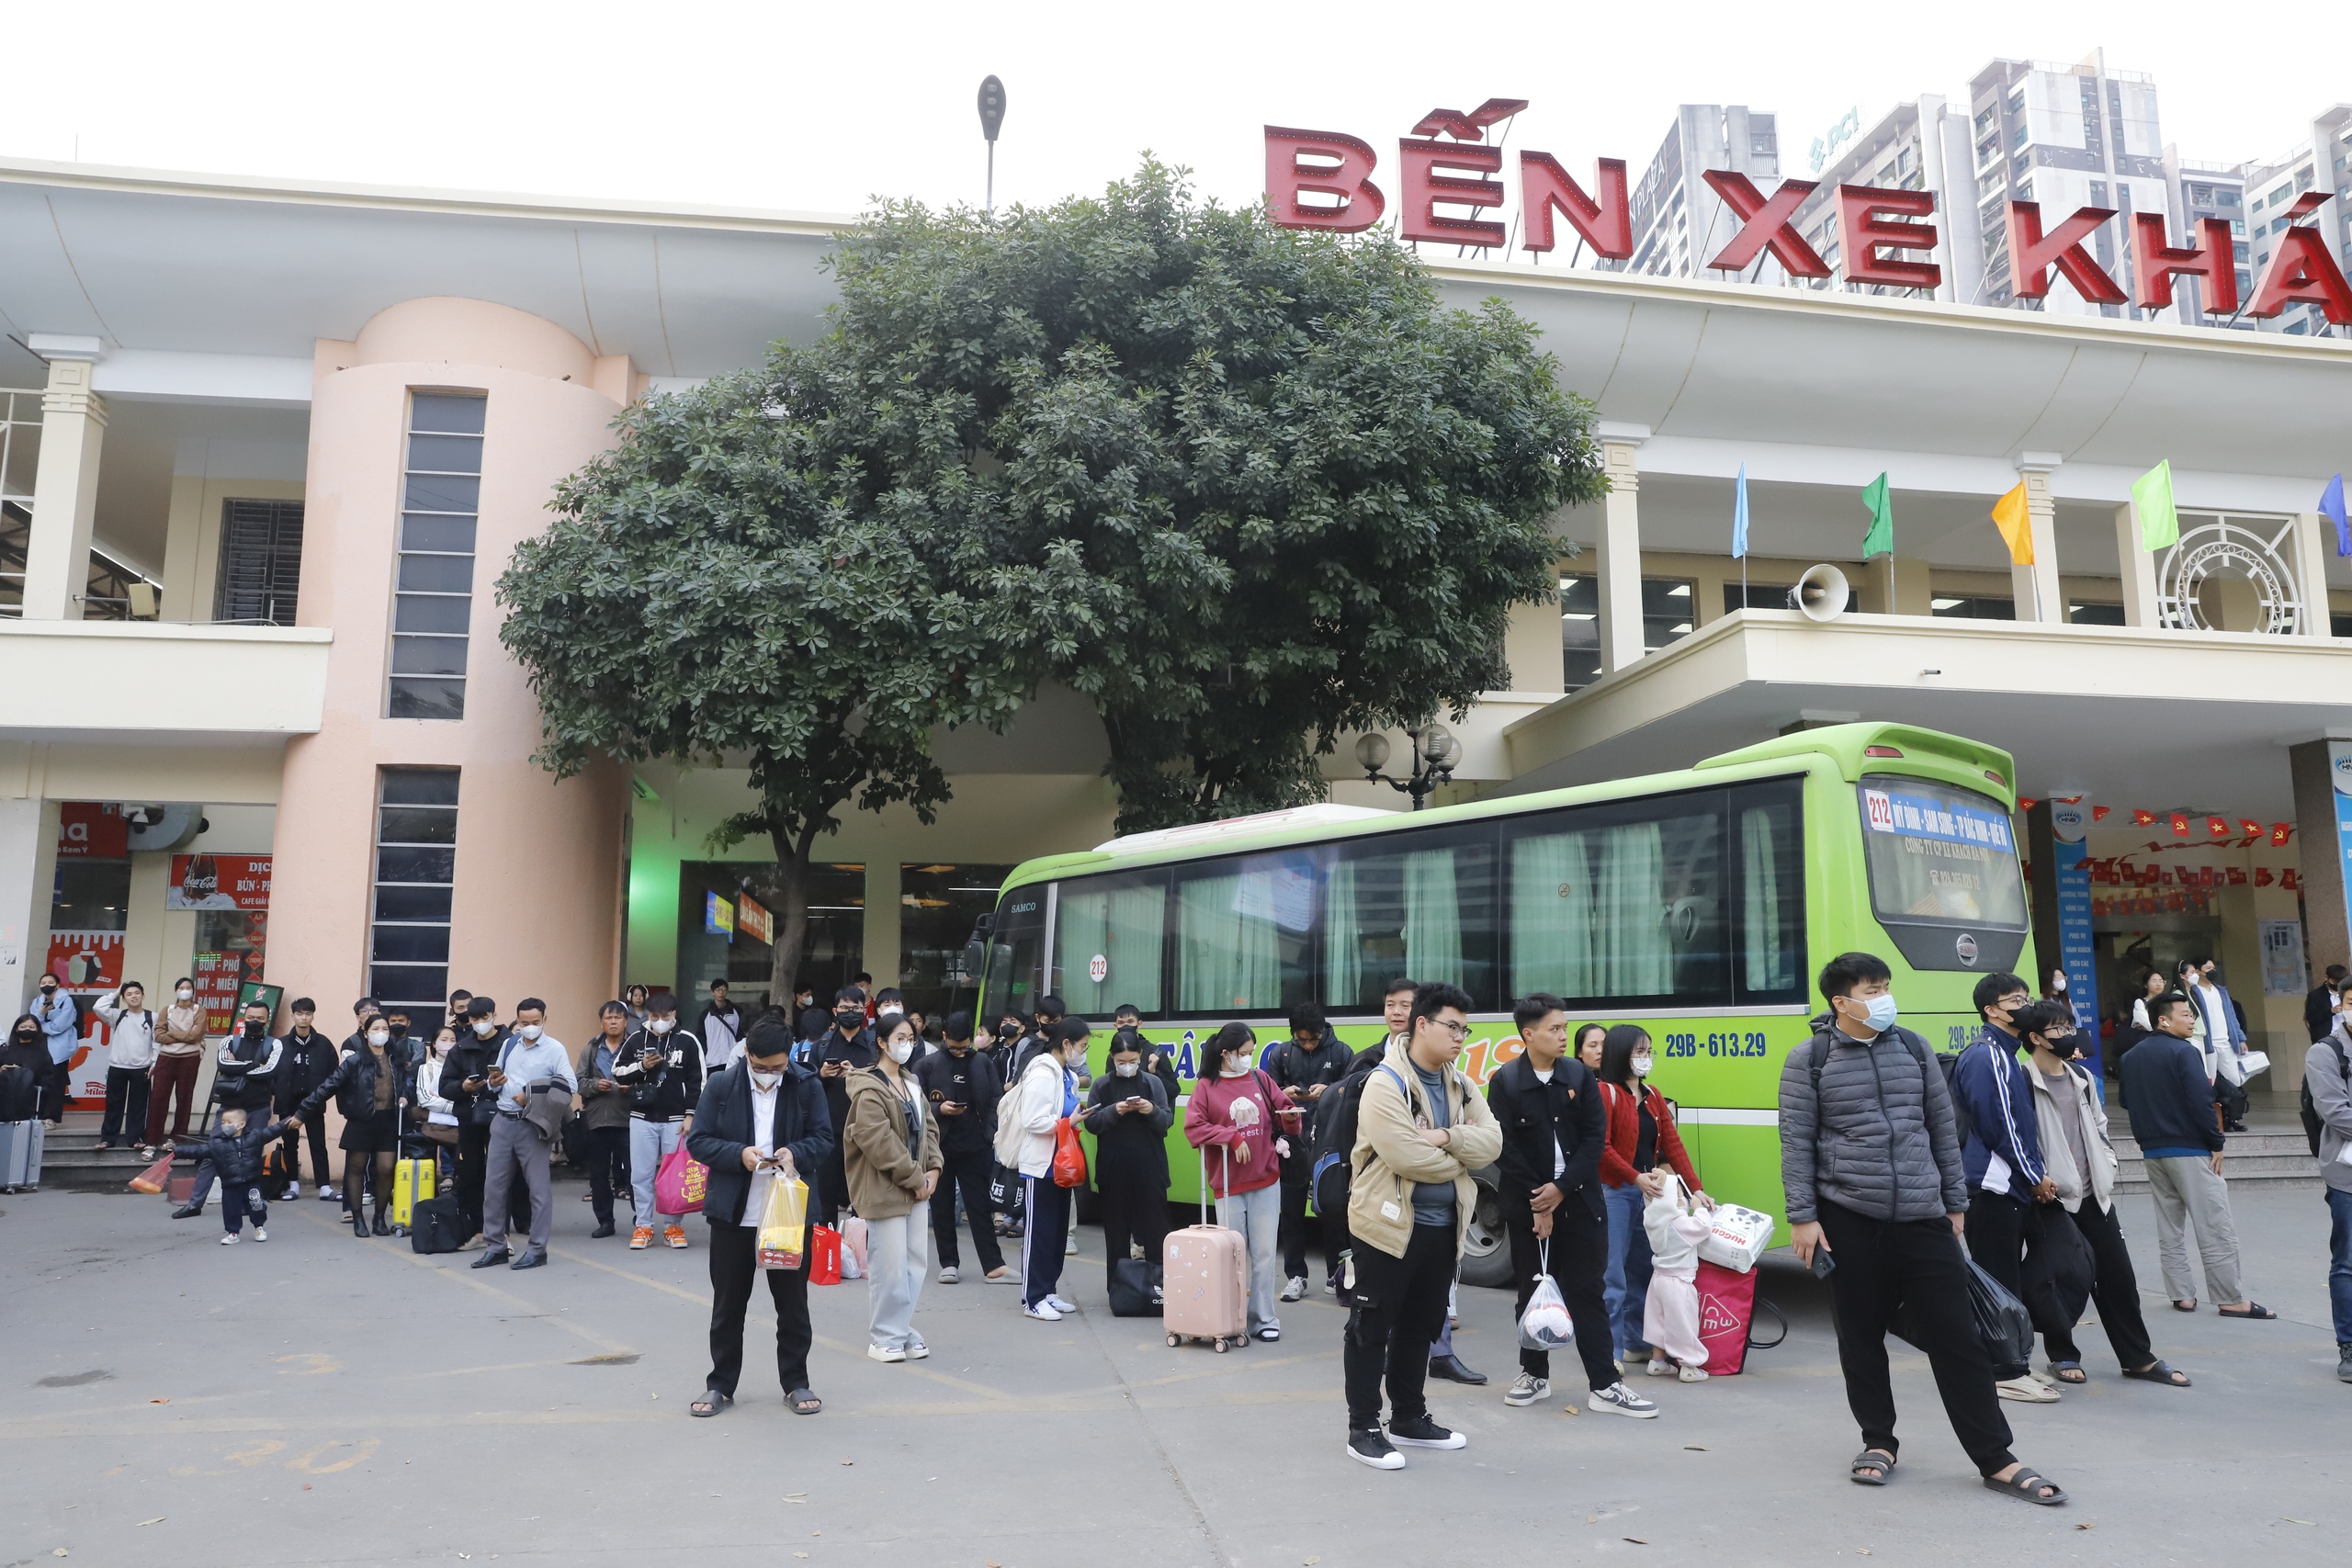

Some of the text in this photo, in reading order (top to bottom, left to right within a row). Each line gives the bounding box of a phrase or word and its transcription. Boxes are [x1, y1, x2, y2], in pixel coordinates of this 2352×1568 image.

[1263, 97, 2352, 325] BẾN XE KHÁ
[1869, 796, 1891, 825] 212
[1893, 800, 1905, 829] MỸ
[1904, 801, 1922, 831] ĐÌNH
[1924, 808, 1939, 834] SAM
[1938, 811, 1956, 837] SUNG
[1956, 815, 1965, 838] TP
[82, 844, 88, 853] Ý
[1923, 839, 1933, 855] TY
[1933, 840, 1942, 856] CP
[1942, 841, 1952, 858] XE
[237, 876, 254, 892] BÚN
[1012, 902, 1036, 913] SAMCO
[222, 955, 240, 972] PHỞ
[1091, 960, 1105, 976] 212
[217, 975, 239, 991] MIẾN
[198, 994, 220, 1010] BÁNH
[209, 1016, 221, 1031] TẠP
[1247, 1128, 1260, 1136] est
